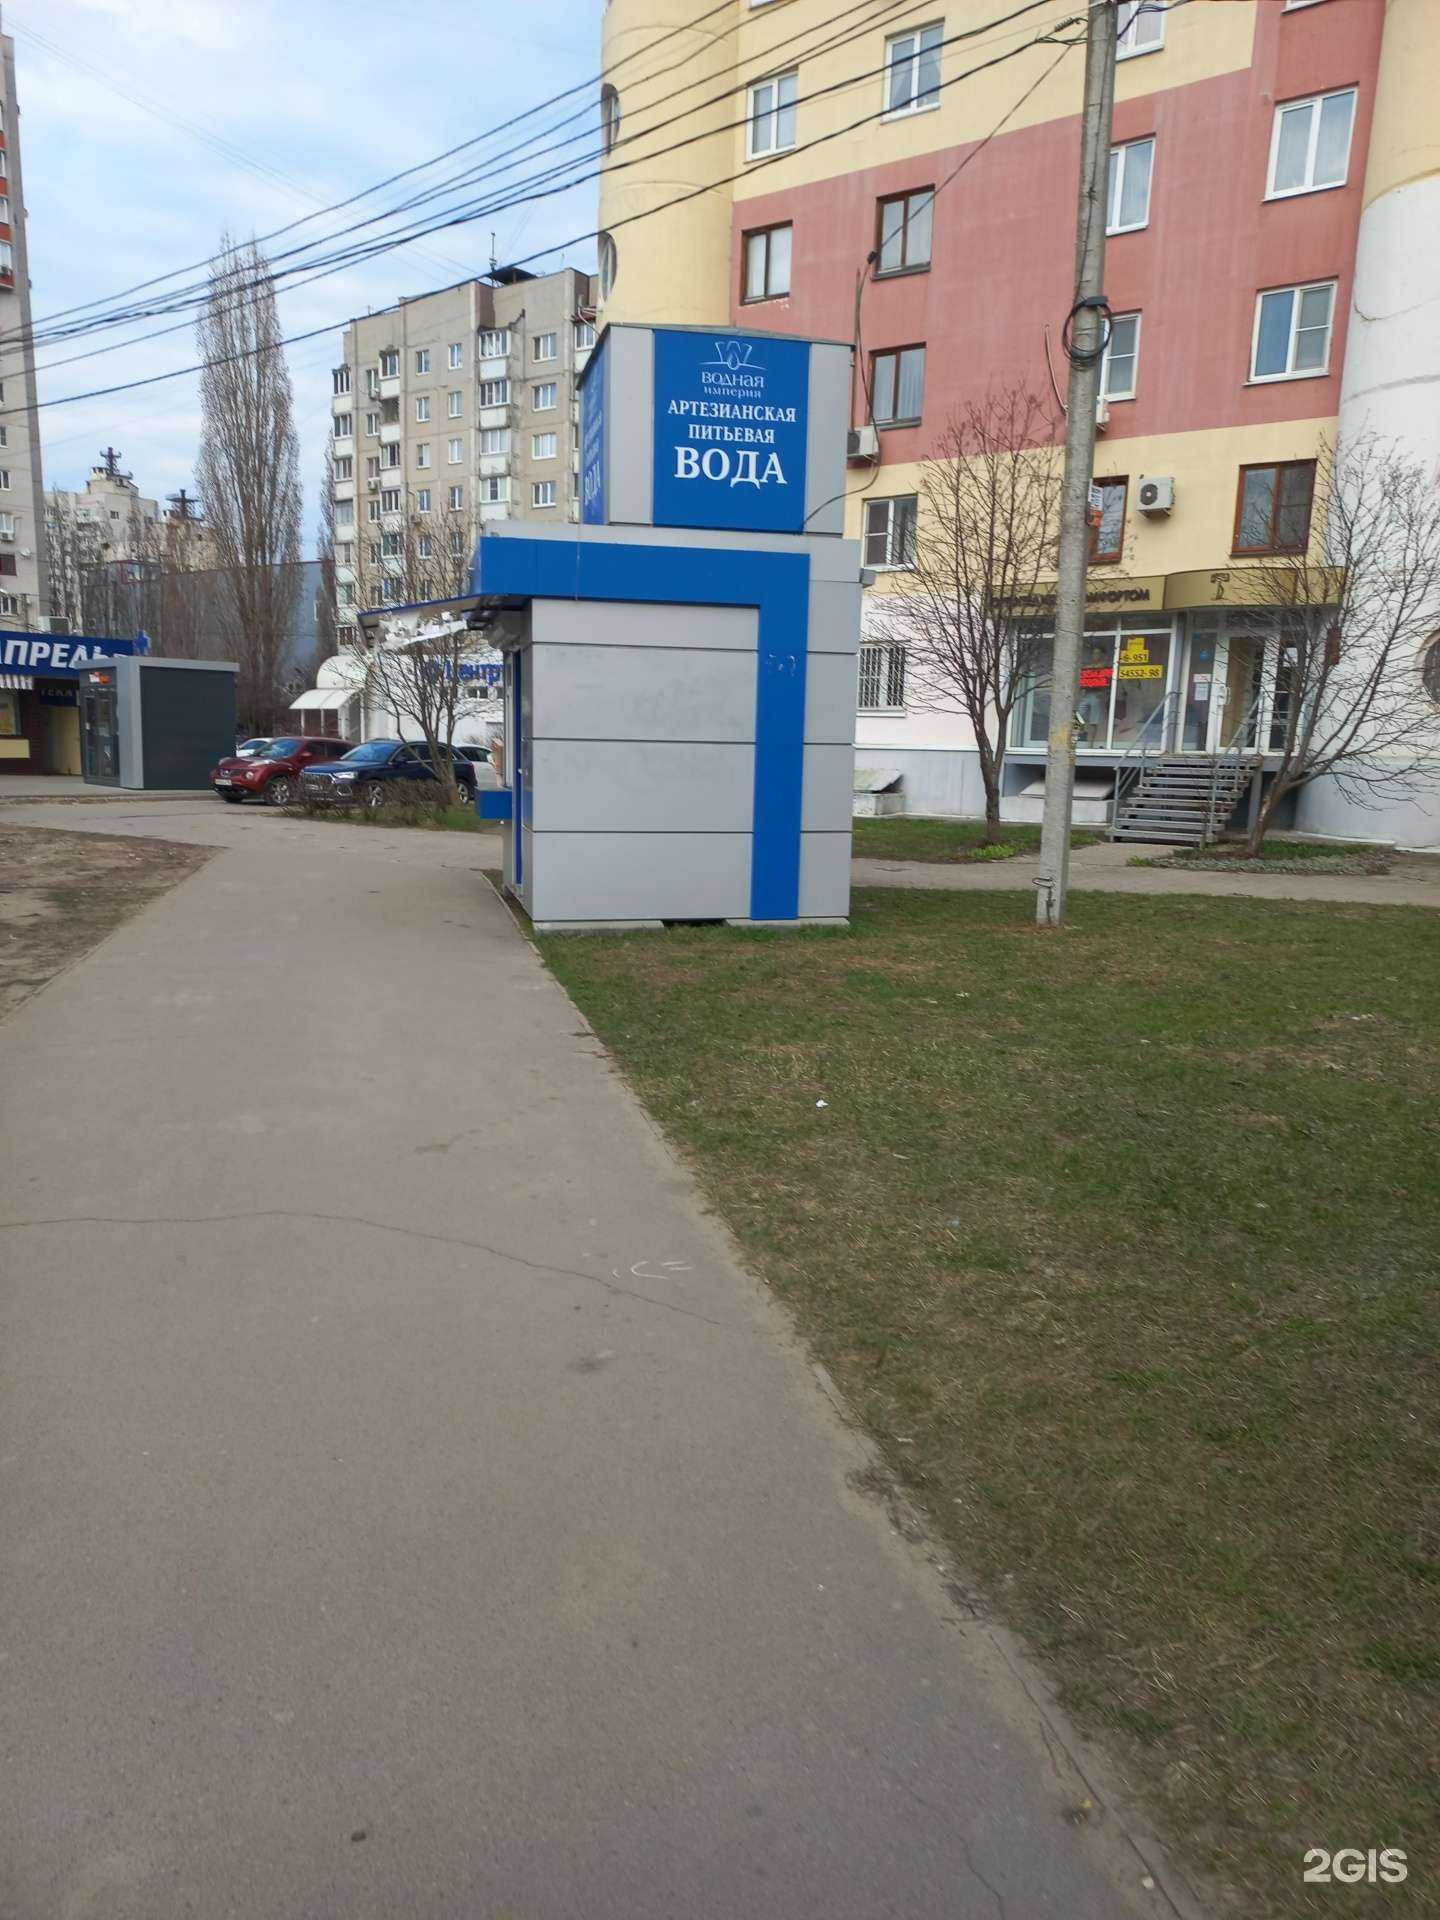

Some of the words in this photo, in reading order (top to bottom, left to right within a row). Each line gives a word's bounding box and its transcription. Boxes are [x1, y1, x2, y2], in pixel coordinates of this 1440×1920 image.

[667, 399, 797, 423] АРТЕЗИАНСКАЯ
[688, 423, 776, 444] ПИТЬЕВАЯ
[673, 446, 788, 490] ВОДА
